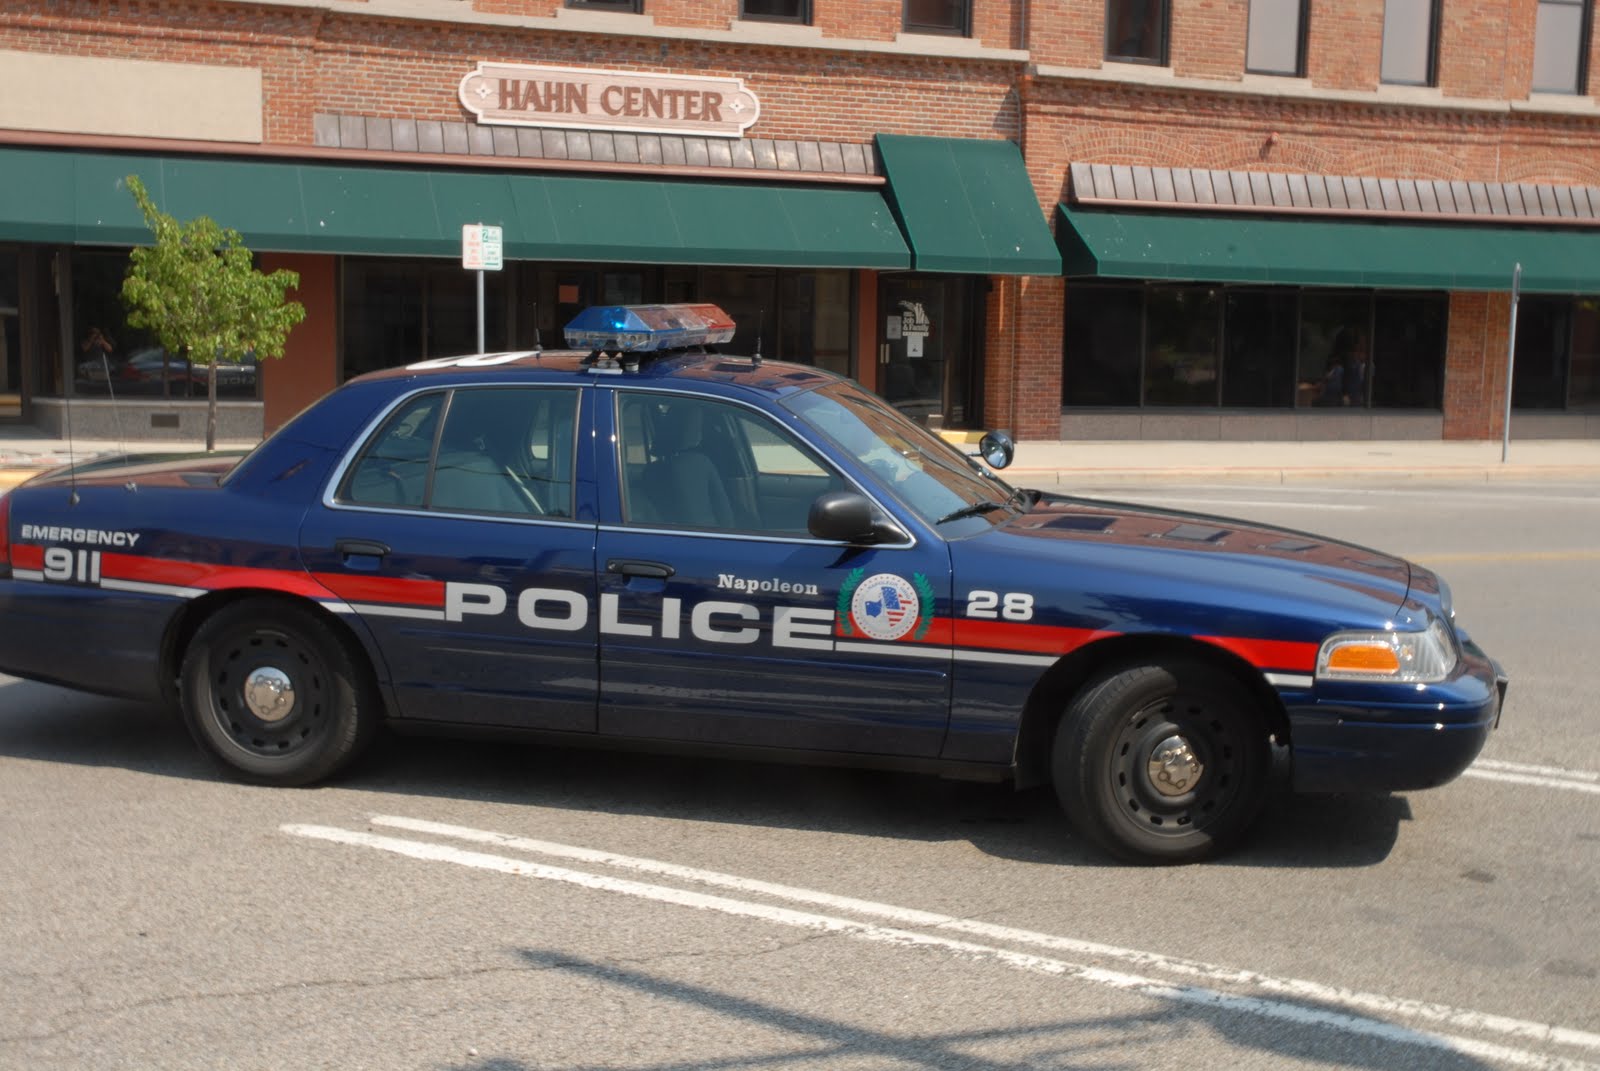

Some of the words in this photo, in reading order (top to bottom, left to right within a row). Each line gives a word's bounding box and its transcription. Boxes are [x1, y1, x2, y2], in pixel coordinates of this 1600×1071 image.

[498, 78, 588, 114] HAHN
[600, 85, 723, 122] CENTER
[21, 524, 140, 547] EMERGENCY
[44, 547, 100, 583] 911
[717, 573, 818, 595] Napoleon
[445, 581, 835, 651] POLICE
[966, 590, 1034, 621] 28
